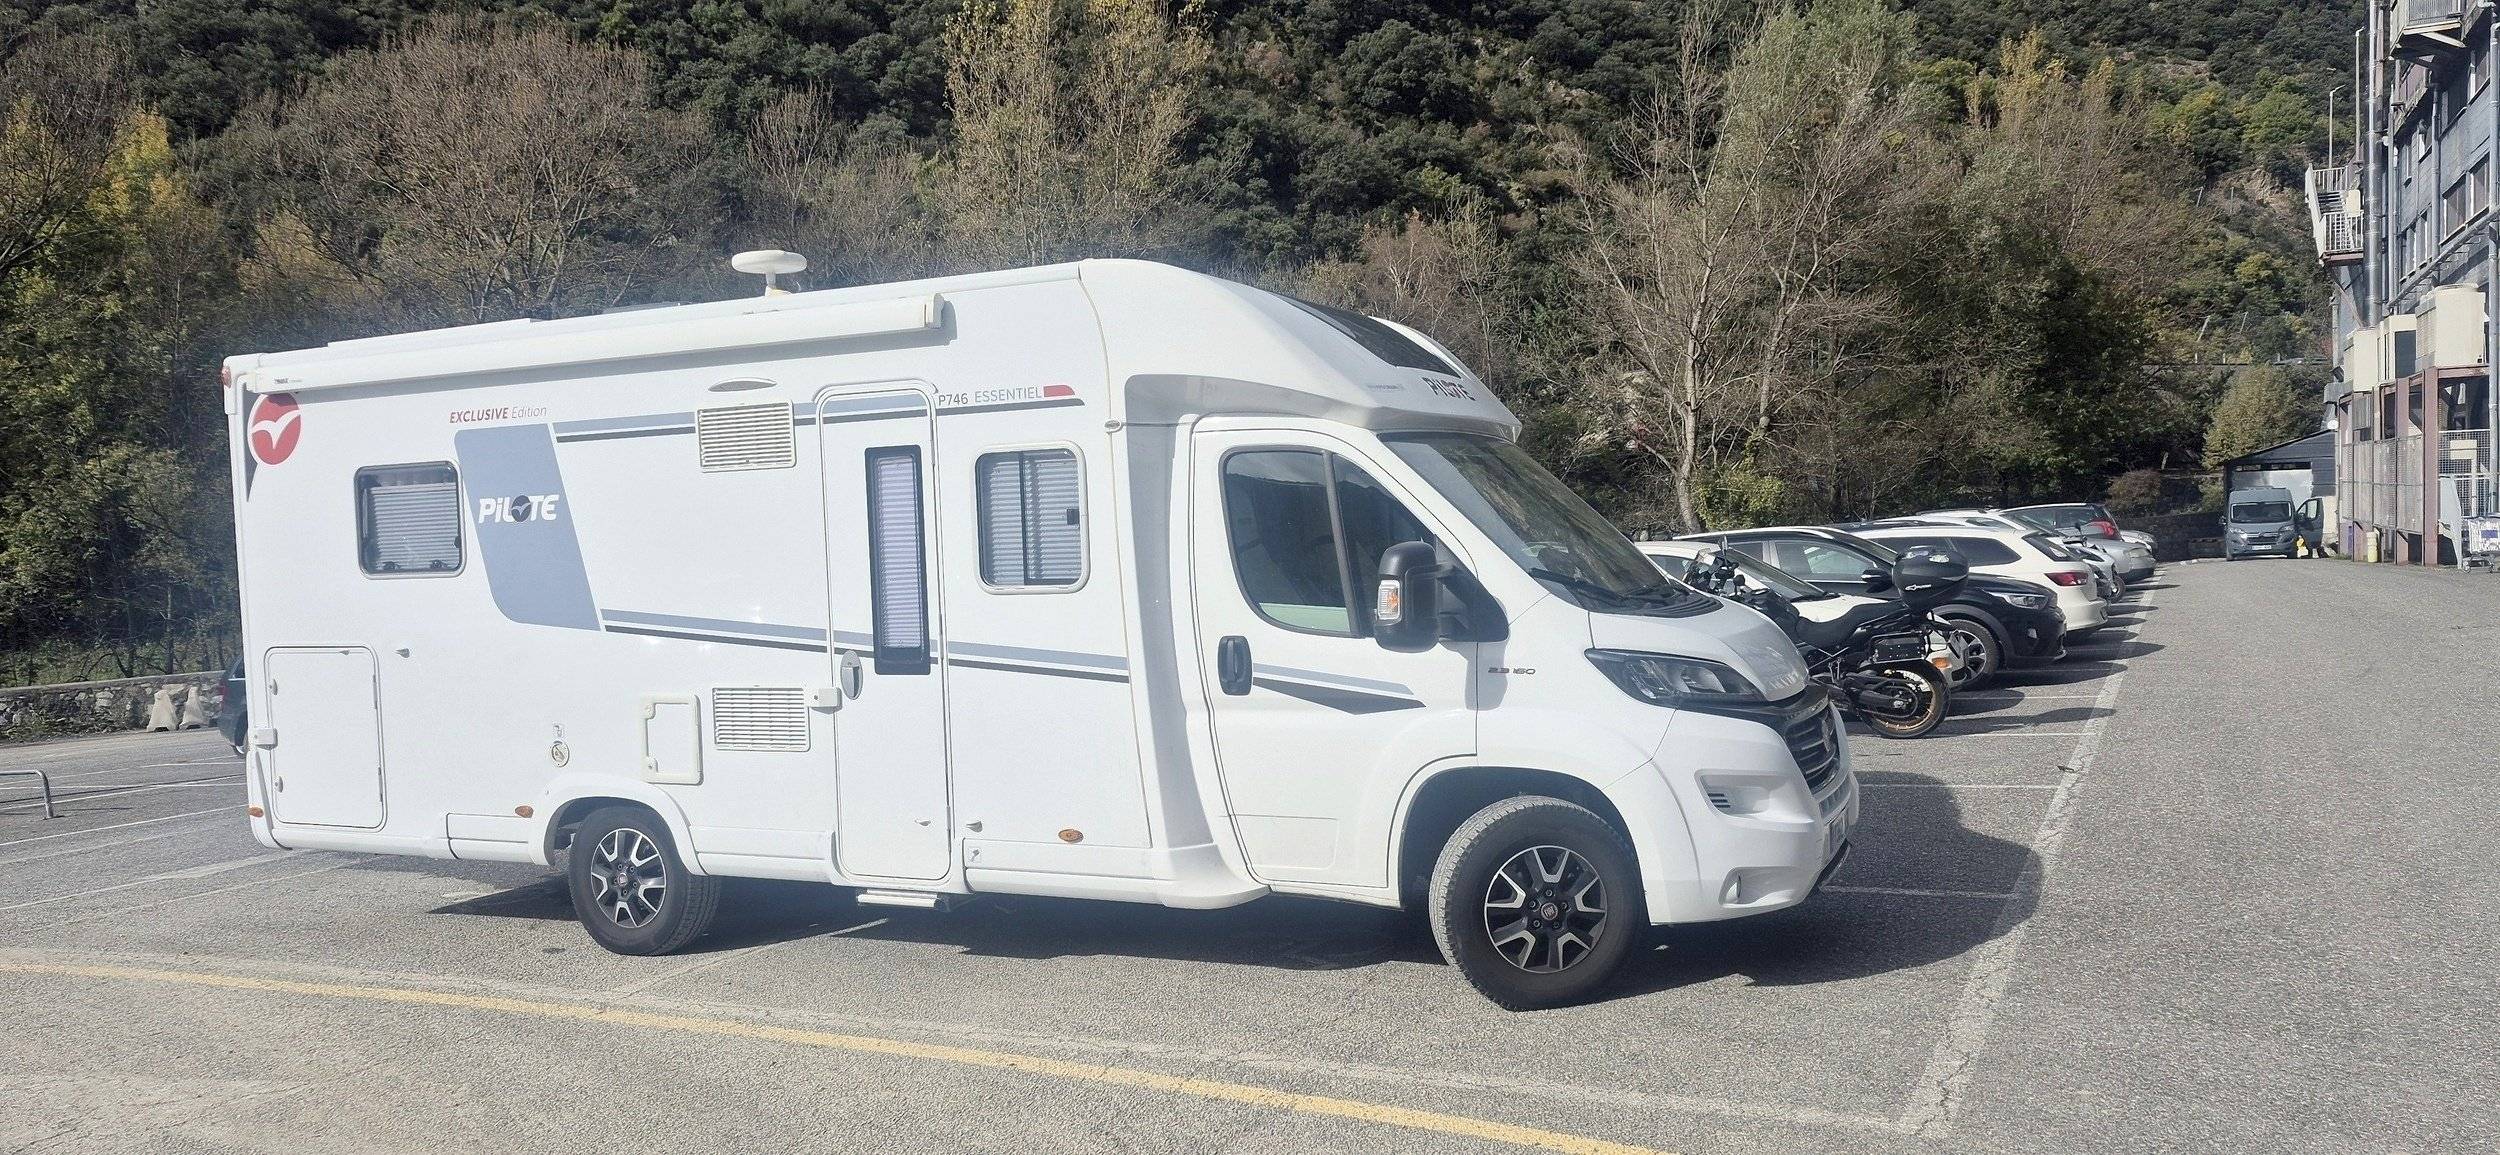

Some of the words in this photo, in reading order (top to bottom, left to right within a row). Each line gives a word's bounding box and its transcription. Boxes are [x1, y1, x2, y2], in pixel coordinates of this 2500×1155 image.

[938, 393, 969, 406] P746
[974, 386, 1042, 403] ESSENTIEL
[449, 407, 509, 424] EXCLUSIVE
[511, 404, 547, 419] Edition
